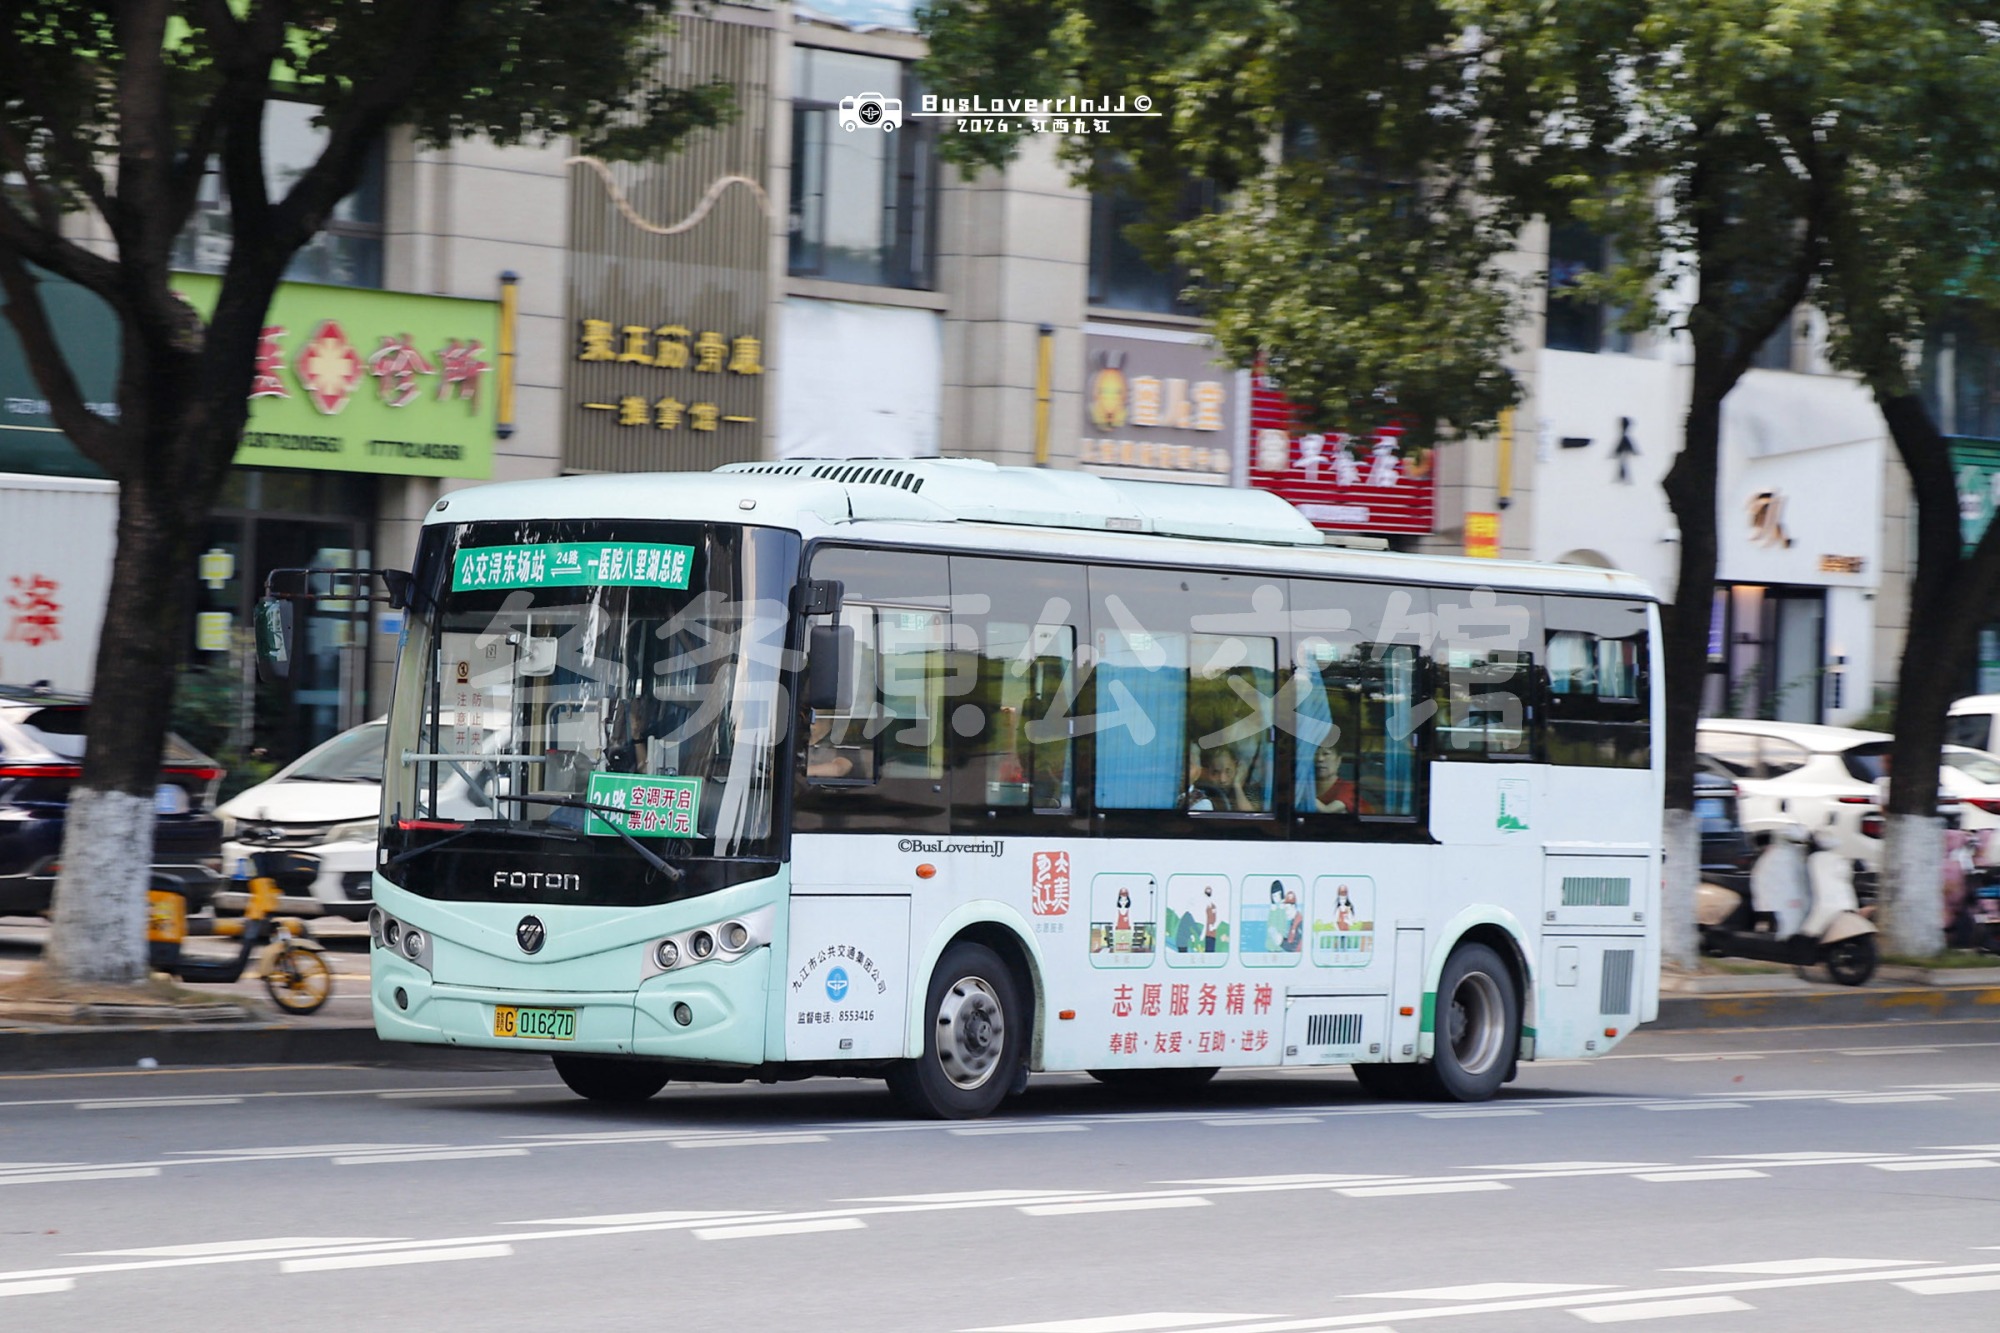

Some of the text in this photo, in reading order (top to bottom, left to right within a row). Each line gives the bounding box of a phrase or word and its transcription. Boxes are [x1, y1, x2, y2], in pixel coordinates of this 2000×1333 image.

[461, 548, 686, 586] 公交浔东场站 24路 一医院八里湖总院
[630, 785, 693, 810] 空调开启
[493, 871, 580, 891] FOTON
[792, 944, 887, 995] 九江市公共交通集团公司
[1112, 982, 1273, 1018] 志愿服务精神
